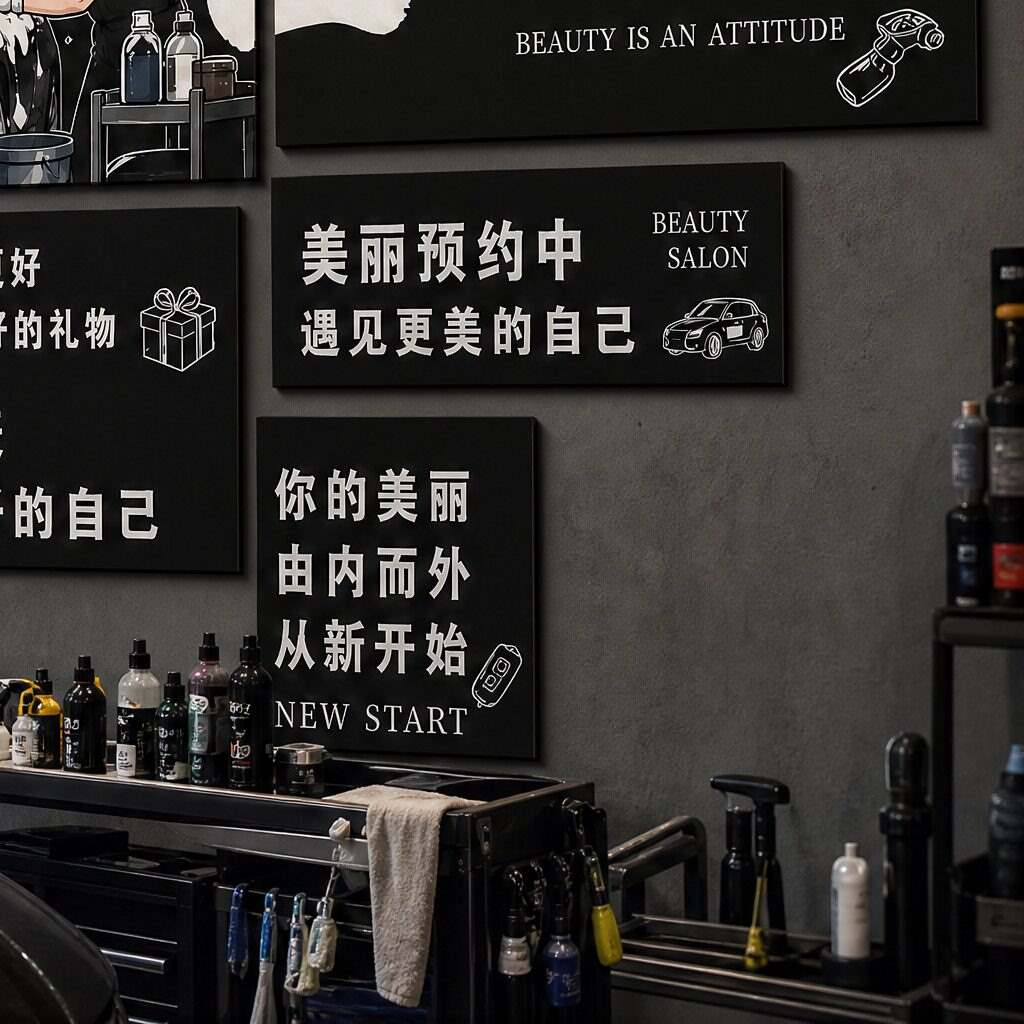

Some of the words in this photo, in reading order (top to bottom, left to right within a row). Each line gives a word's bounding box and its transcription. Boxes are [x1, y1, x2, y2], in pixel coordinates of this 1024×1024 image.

[515, 27, 617, 55] BEAUTY
[627, 25, 650, 50] IS
[659, 23, 697, 48] AN
[707, 16, 846, 46] ATTITUDE
[652, 209, 749, 234] BEAUTY
[302, 217, 582, 286] 美丽预约中
[667, 245, 749, 270] SALON
[300, 304, 635, 357] 遇见更美的自己
[274, 467, 470, 523] 你的美丽
[278, 543, 471, 601] 由内而外
[274, 618, 468, 676] 从新开始
[275, 700, 350, 730] NEW
[365, 703, 468, 735] START
